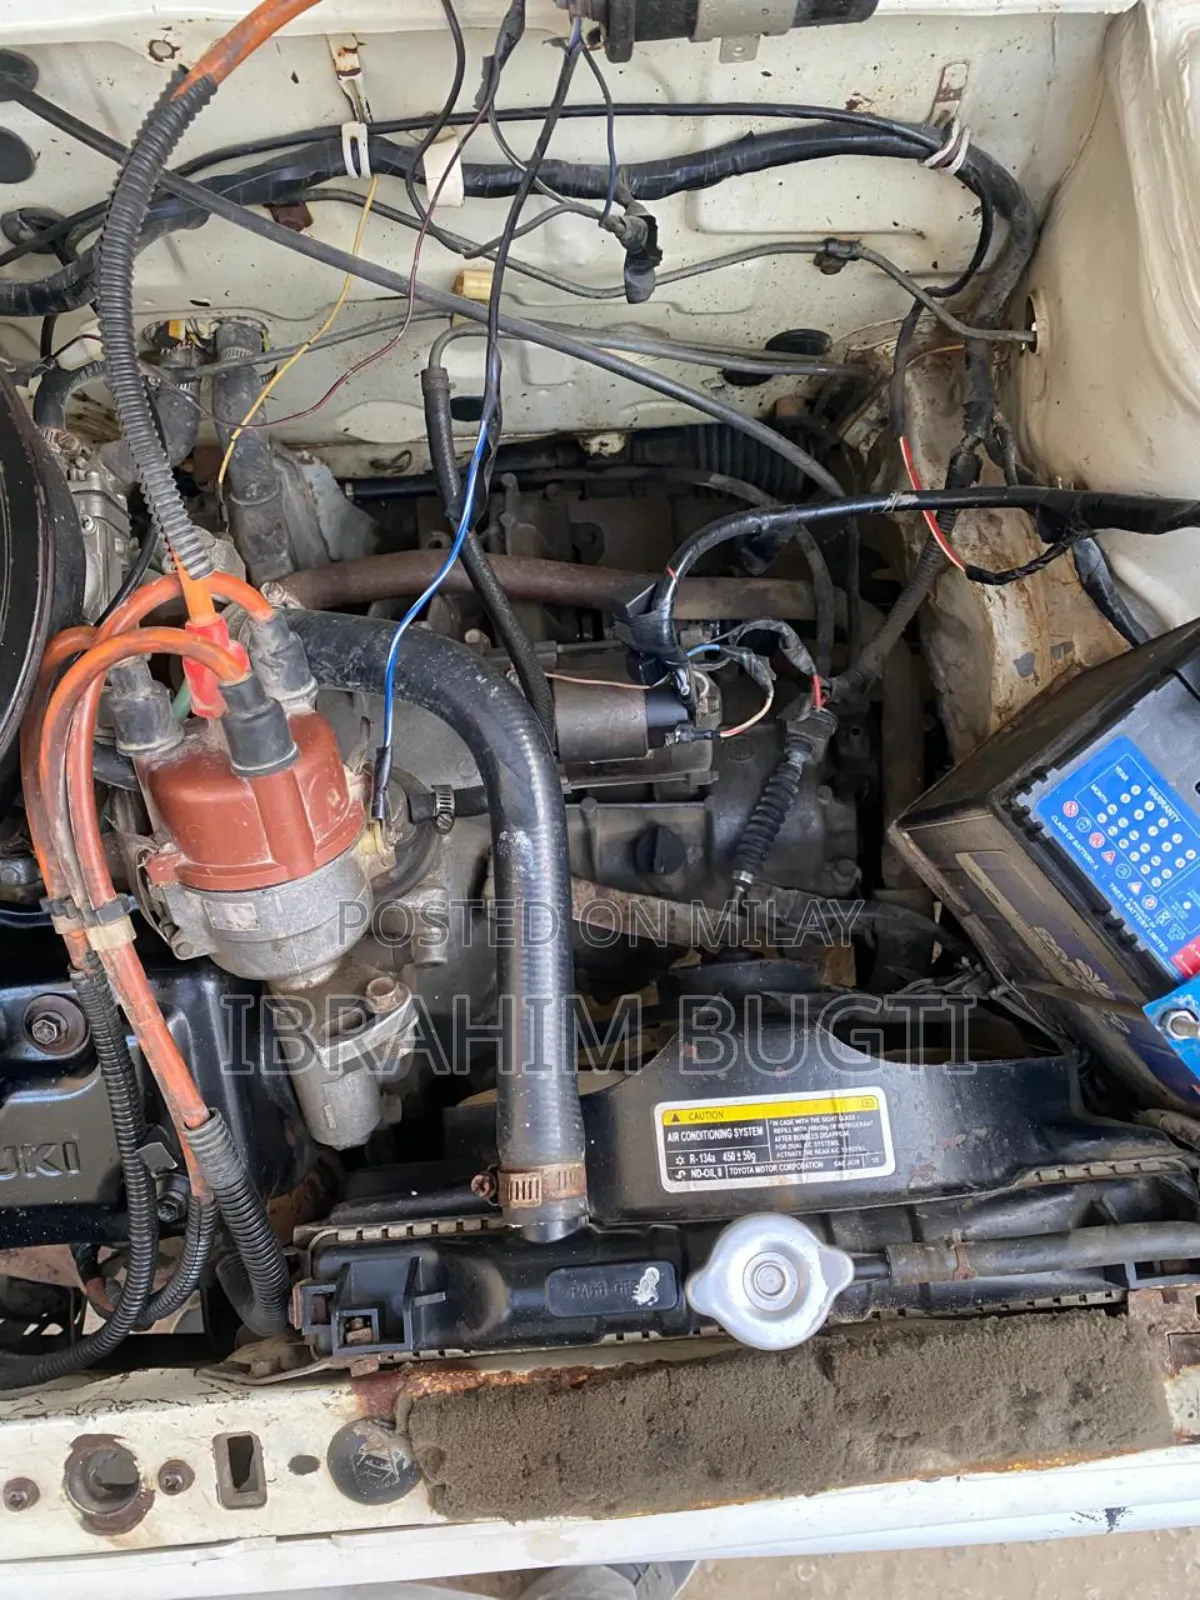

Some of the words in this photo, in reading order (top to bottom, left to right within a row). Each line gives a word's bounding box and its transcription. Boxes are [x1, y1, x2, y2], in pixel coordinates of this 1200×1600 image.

[1113, 764, 1130, 782] YEAR
[1089, 783, 1109, 805] MONTH
[1145, 784, 1181, 824] WARRANTY
[1050, 813, 1069, 834] CLASS
[1065, 831, 1074, 841] OF
[1108, 882, 1127, 903] TREET
[1123, 901, 1149, 929] BATTERY
[1146, 927, 1169, 953] LIMITED
[688, 1111, 724, 1121] CAUTION
[667, 1131, 680, 1142] AIR
[680, 1128, 732, 1142] CONDITIONING
[733, 1126, 764, 1138] SYSTEM
[689, 1152, 716, 1164] R-134a
[722, 1150, 736, 1162] 450
[743, 1149, 757, 1164] 50g
[729, 1166, 754, 1176] TOYOTA
[755, 1163, 778, 1174] MOTOR
[779, 1160, 824, 1172] CORPORATION
